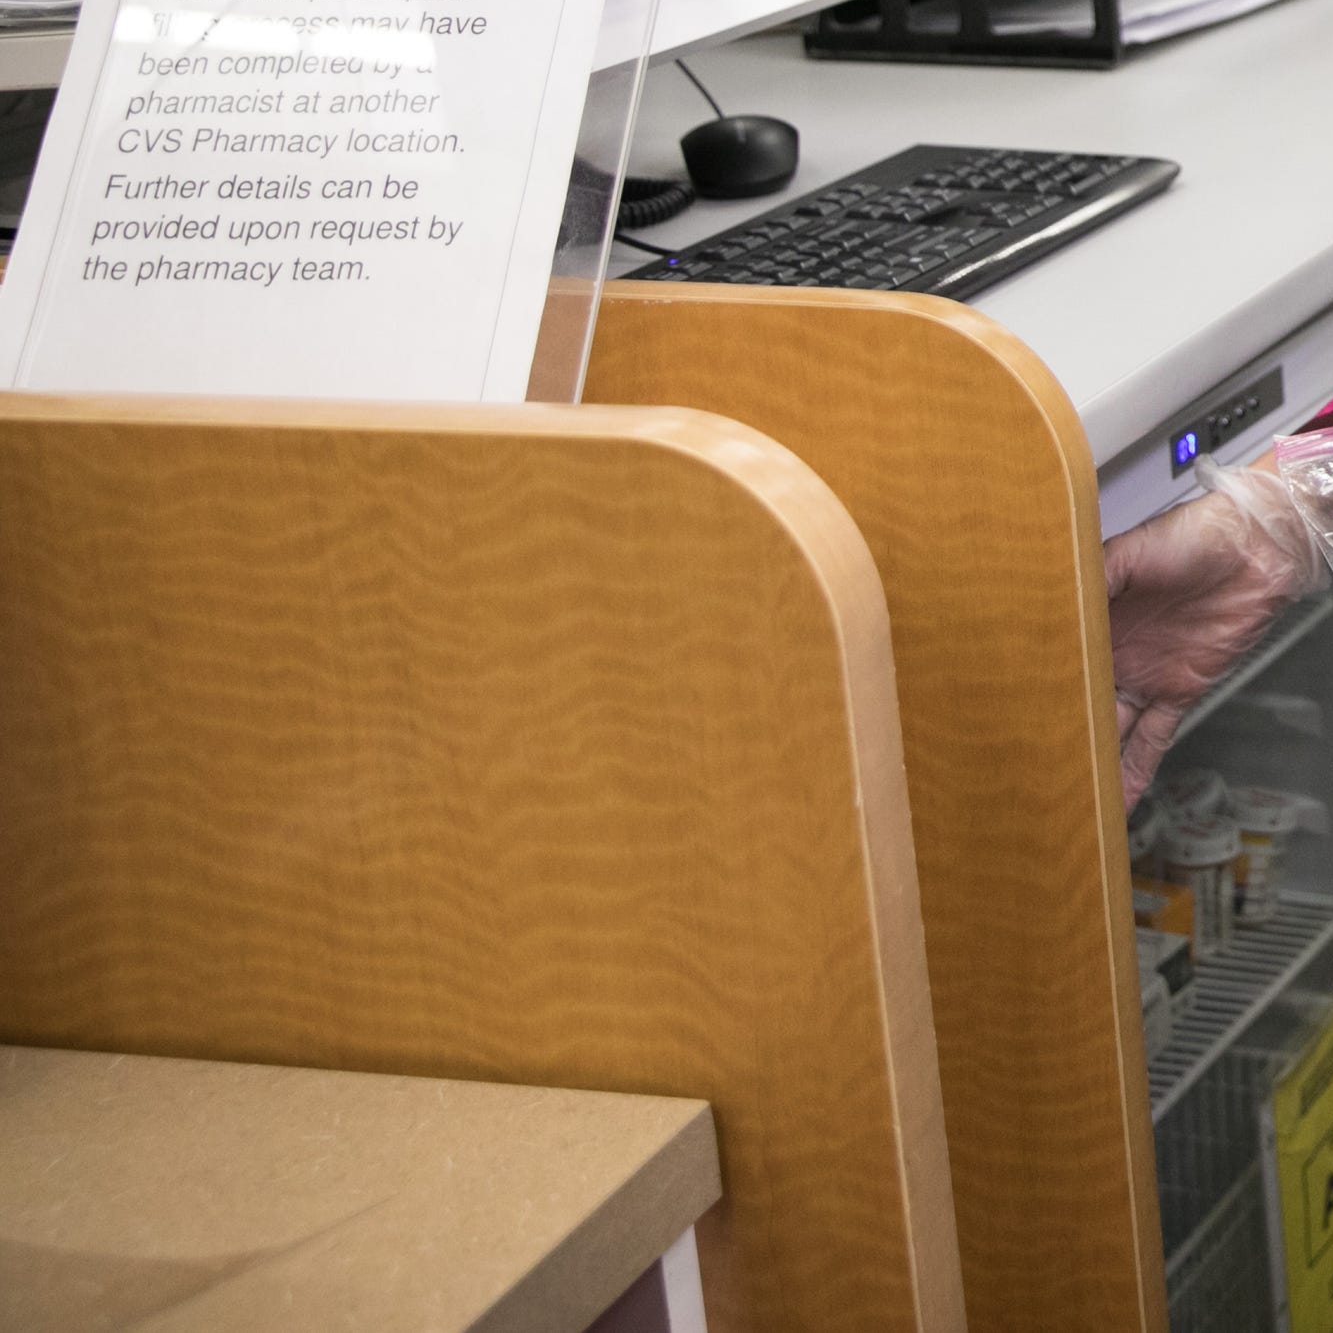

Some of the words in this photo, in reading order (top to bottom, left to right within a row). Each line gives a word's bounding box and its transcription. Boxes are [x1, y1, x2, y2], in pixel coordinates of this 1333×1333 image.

[418, 11, 488, 35] have
[137, 51, 209, 76] been
[217, 49, 364, 80] completed
[125, 89, 286, 120] pharmacist
[292, 92, 320, 114] at
[328, 89, 441, 114] another
[117, 128, 184, 153] CVS
[191, 128, 339, 159] Pharmacy
[345, 128, 467, 153] location.
[104, 174, 210, 200] Further
[216, 174, 312, 200] details
[320, 177, 372, 199] can
[382, 174, 420, 200] be
[91, 214, 220, 246] provided
[227, 216, 301, 247] upon
[309, 217, 420, 247] request
[427, 214, 465, 246] by
[81, 255, 128, 282] the
[134, 254, 284, 287] pharmacy
[290, 256, 372, 282] team.
